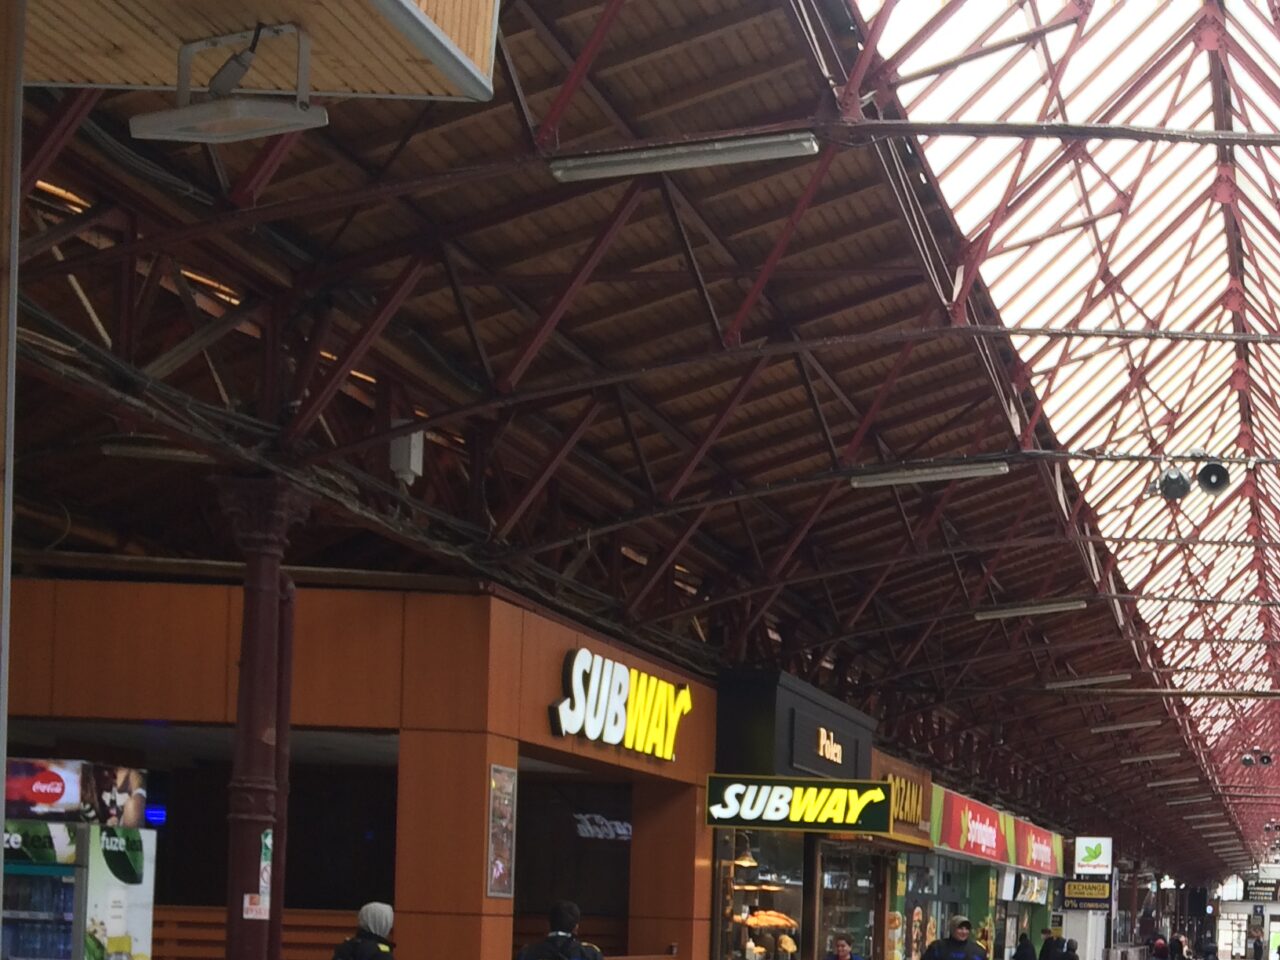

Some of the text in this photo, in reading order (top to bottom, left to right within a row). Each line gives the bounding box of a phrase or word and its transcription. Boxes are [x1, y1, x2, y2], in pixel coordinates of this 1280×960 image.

[558, 647, 692, 761] SUBWAY
[709, 783, 885, 824] SUBWAY
[888, 773, 923, 825] OZANA
[3, 832, 22, 849] ze
[101, 832, 126, 850] fuze
[1068, 883, 1106, 891] EXCHANGE
[1064, 899, 1078, 908] 0%
